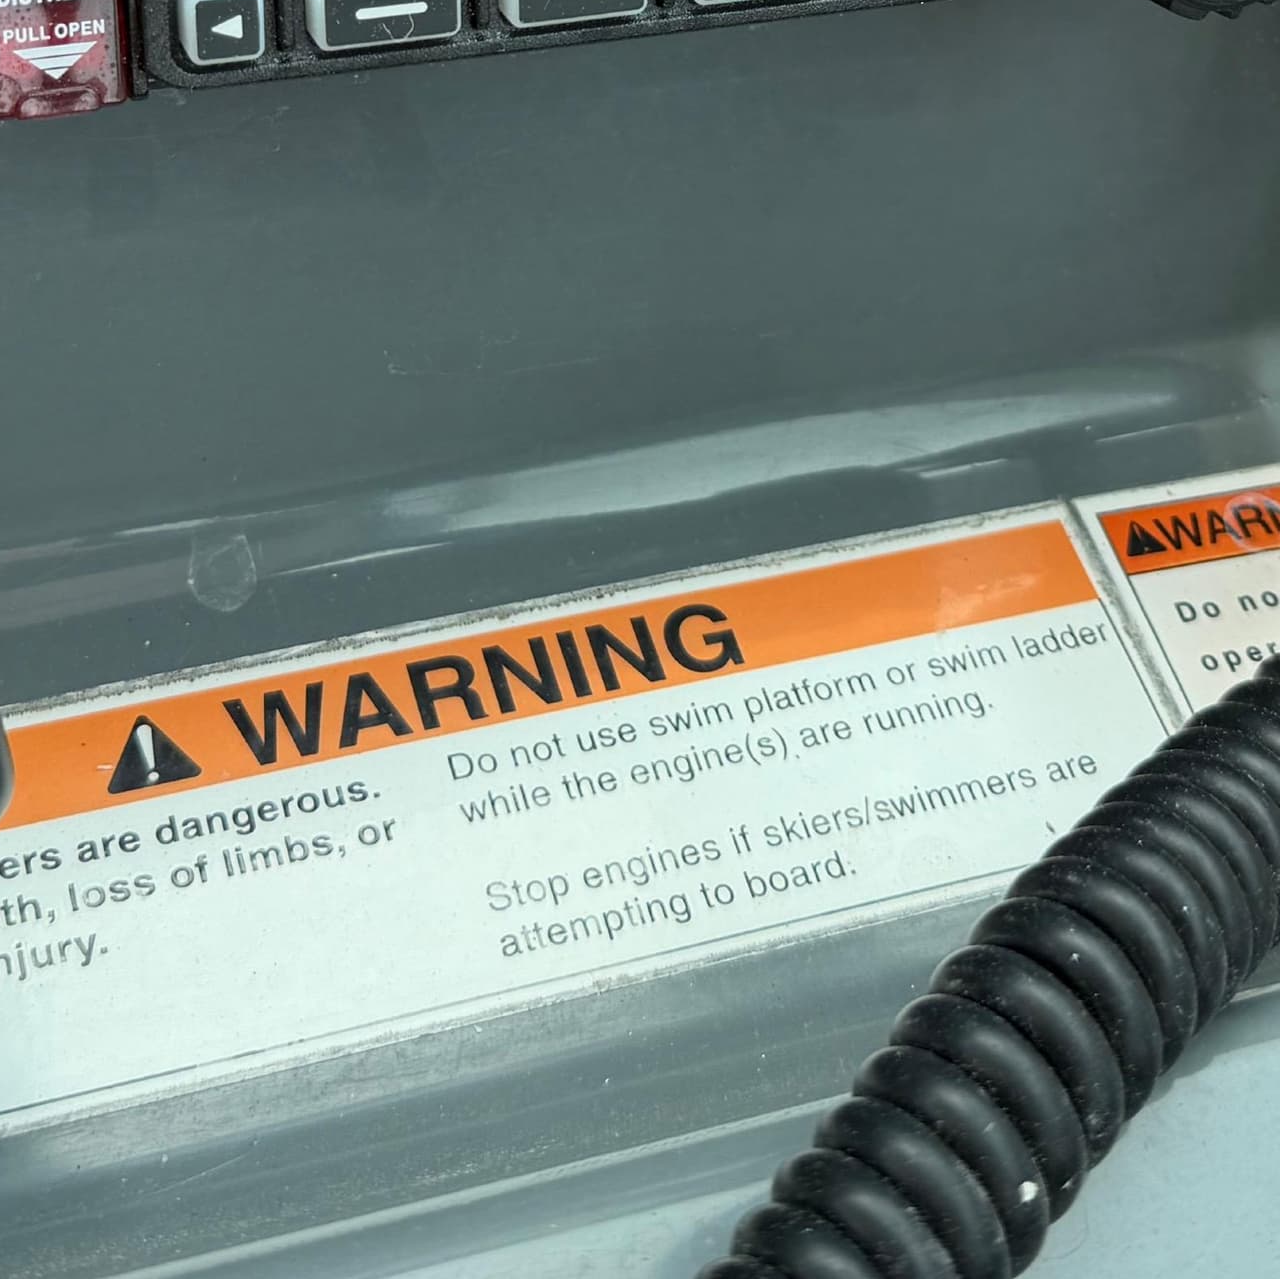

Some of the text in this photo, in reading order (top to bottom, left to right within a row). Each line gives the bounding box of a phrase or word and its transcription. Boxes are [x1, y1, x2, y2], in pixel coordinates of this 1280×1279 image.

[2, 19, 106, 44] PULL OPEN
[1174, 600, 1221, 623] Do
[222, 603, 745, 765] WARNING
[447, 621, 1109, 781] Do not use swim platform or swim ladder
[459, 690, 995, 824] while the engine(s) are running.
[68, 872, 157, 912] loss
[170, 853, 209, 888] of
[222, 834, 347, 878] limbs,
[357, 817, 397, 846] or
[76, 829, 141, 864] are
[154, 780, 382, 844] dangerous.
[485, 753, 1099, 912] Stop engines if skiers/swimmers are
[499, 849, 858, 958] attempting to board.
